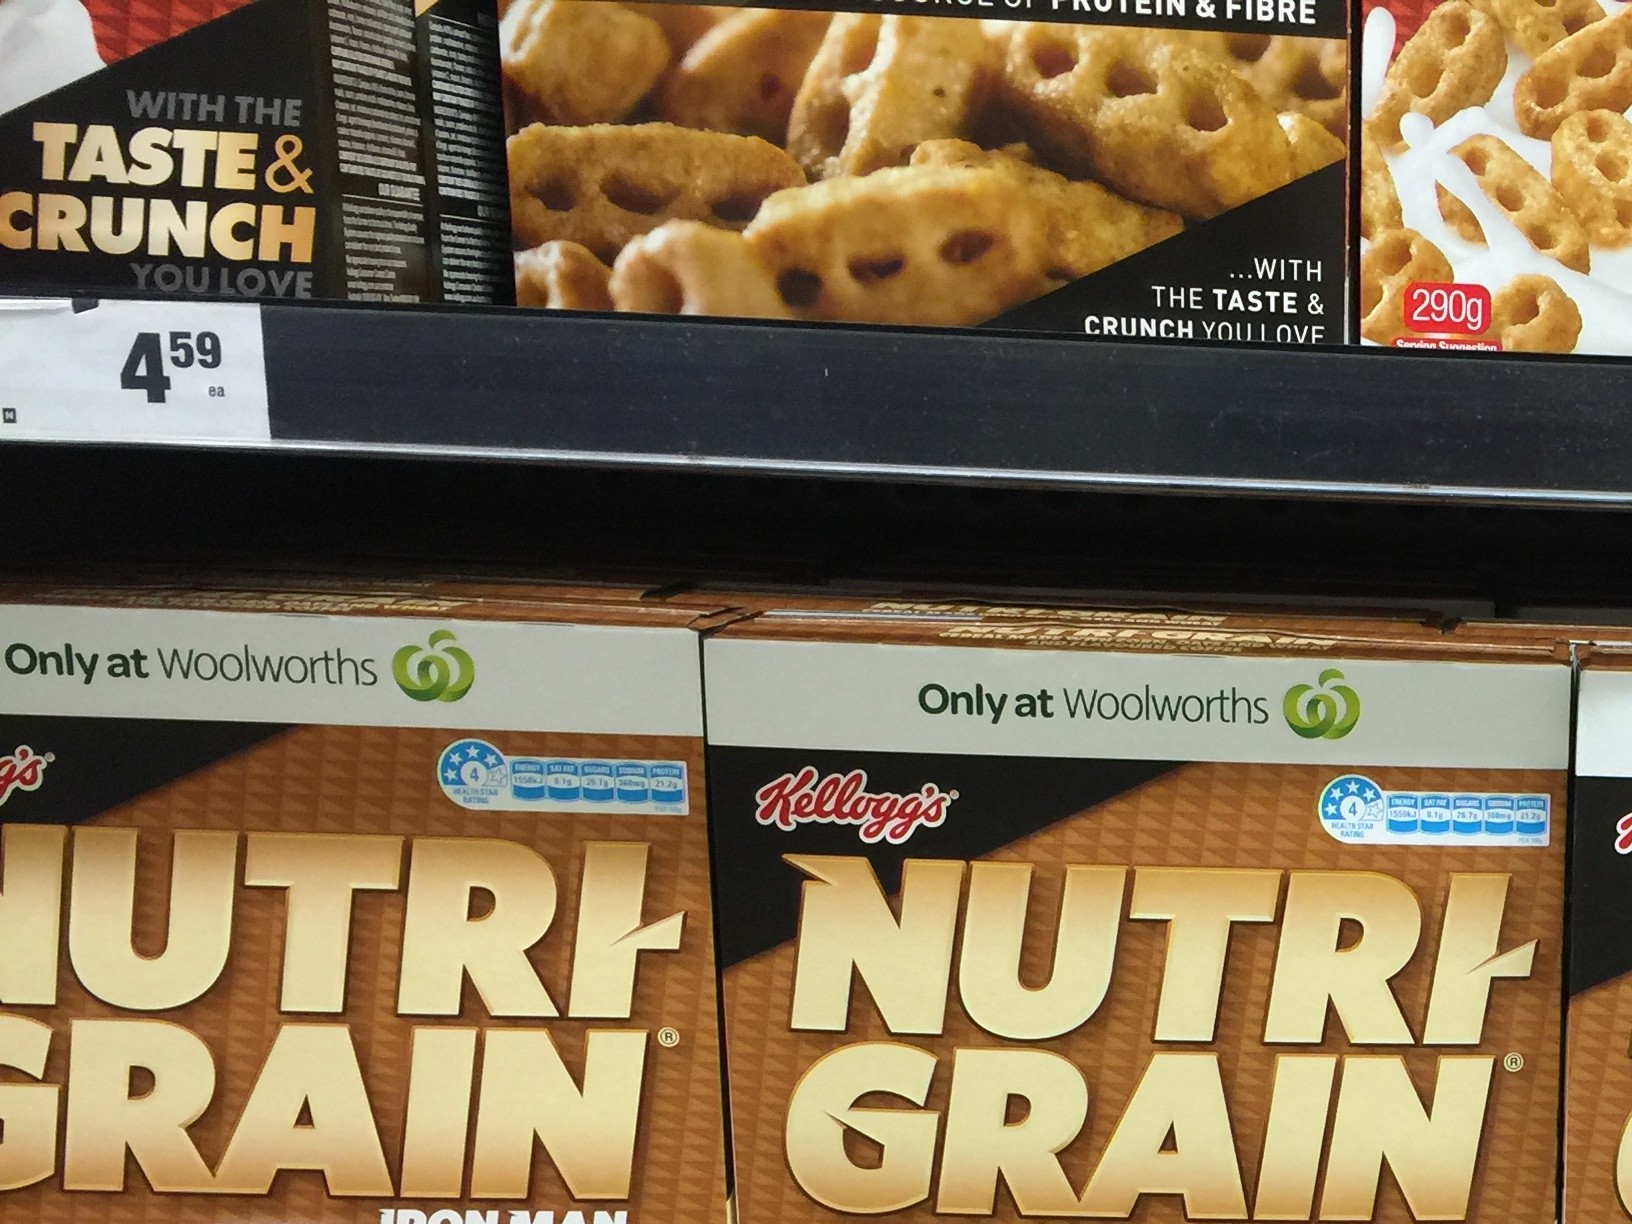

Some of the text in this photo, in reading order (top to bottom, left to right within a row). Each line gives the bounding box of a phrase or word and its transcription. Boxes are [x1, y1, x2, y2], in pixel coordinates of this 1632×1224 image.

[1226, 0, 1316, 24] FIBRE
[126, 90, 302, 127] WITH THE
[0, 191, 316, 264] CRUNCH
[131, 262, 313, 298] YOU LOVE
[1152, 286, 1325, 315] THE TASTE &
[1412, 289, 1483, 331] 290g
[1084, 315, 1193, 338] CRUNCH
[1202, 320, 1251, 341] YOU
[208, 385, 225, 398] ea
[5, 642, 379, 687] Only at Woolworths
[917, 683, 1270, 727] Only at Woolworths
[754, 765, 950, 846] Kellogg's
[784, 1040, 1497, 1224] GRAIN
